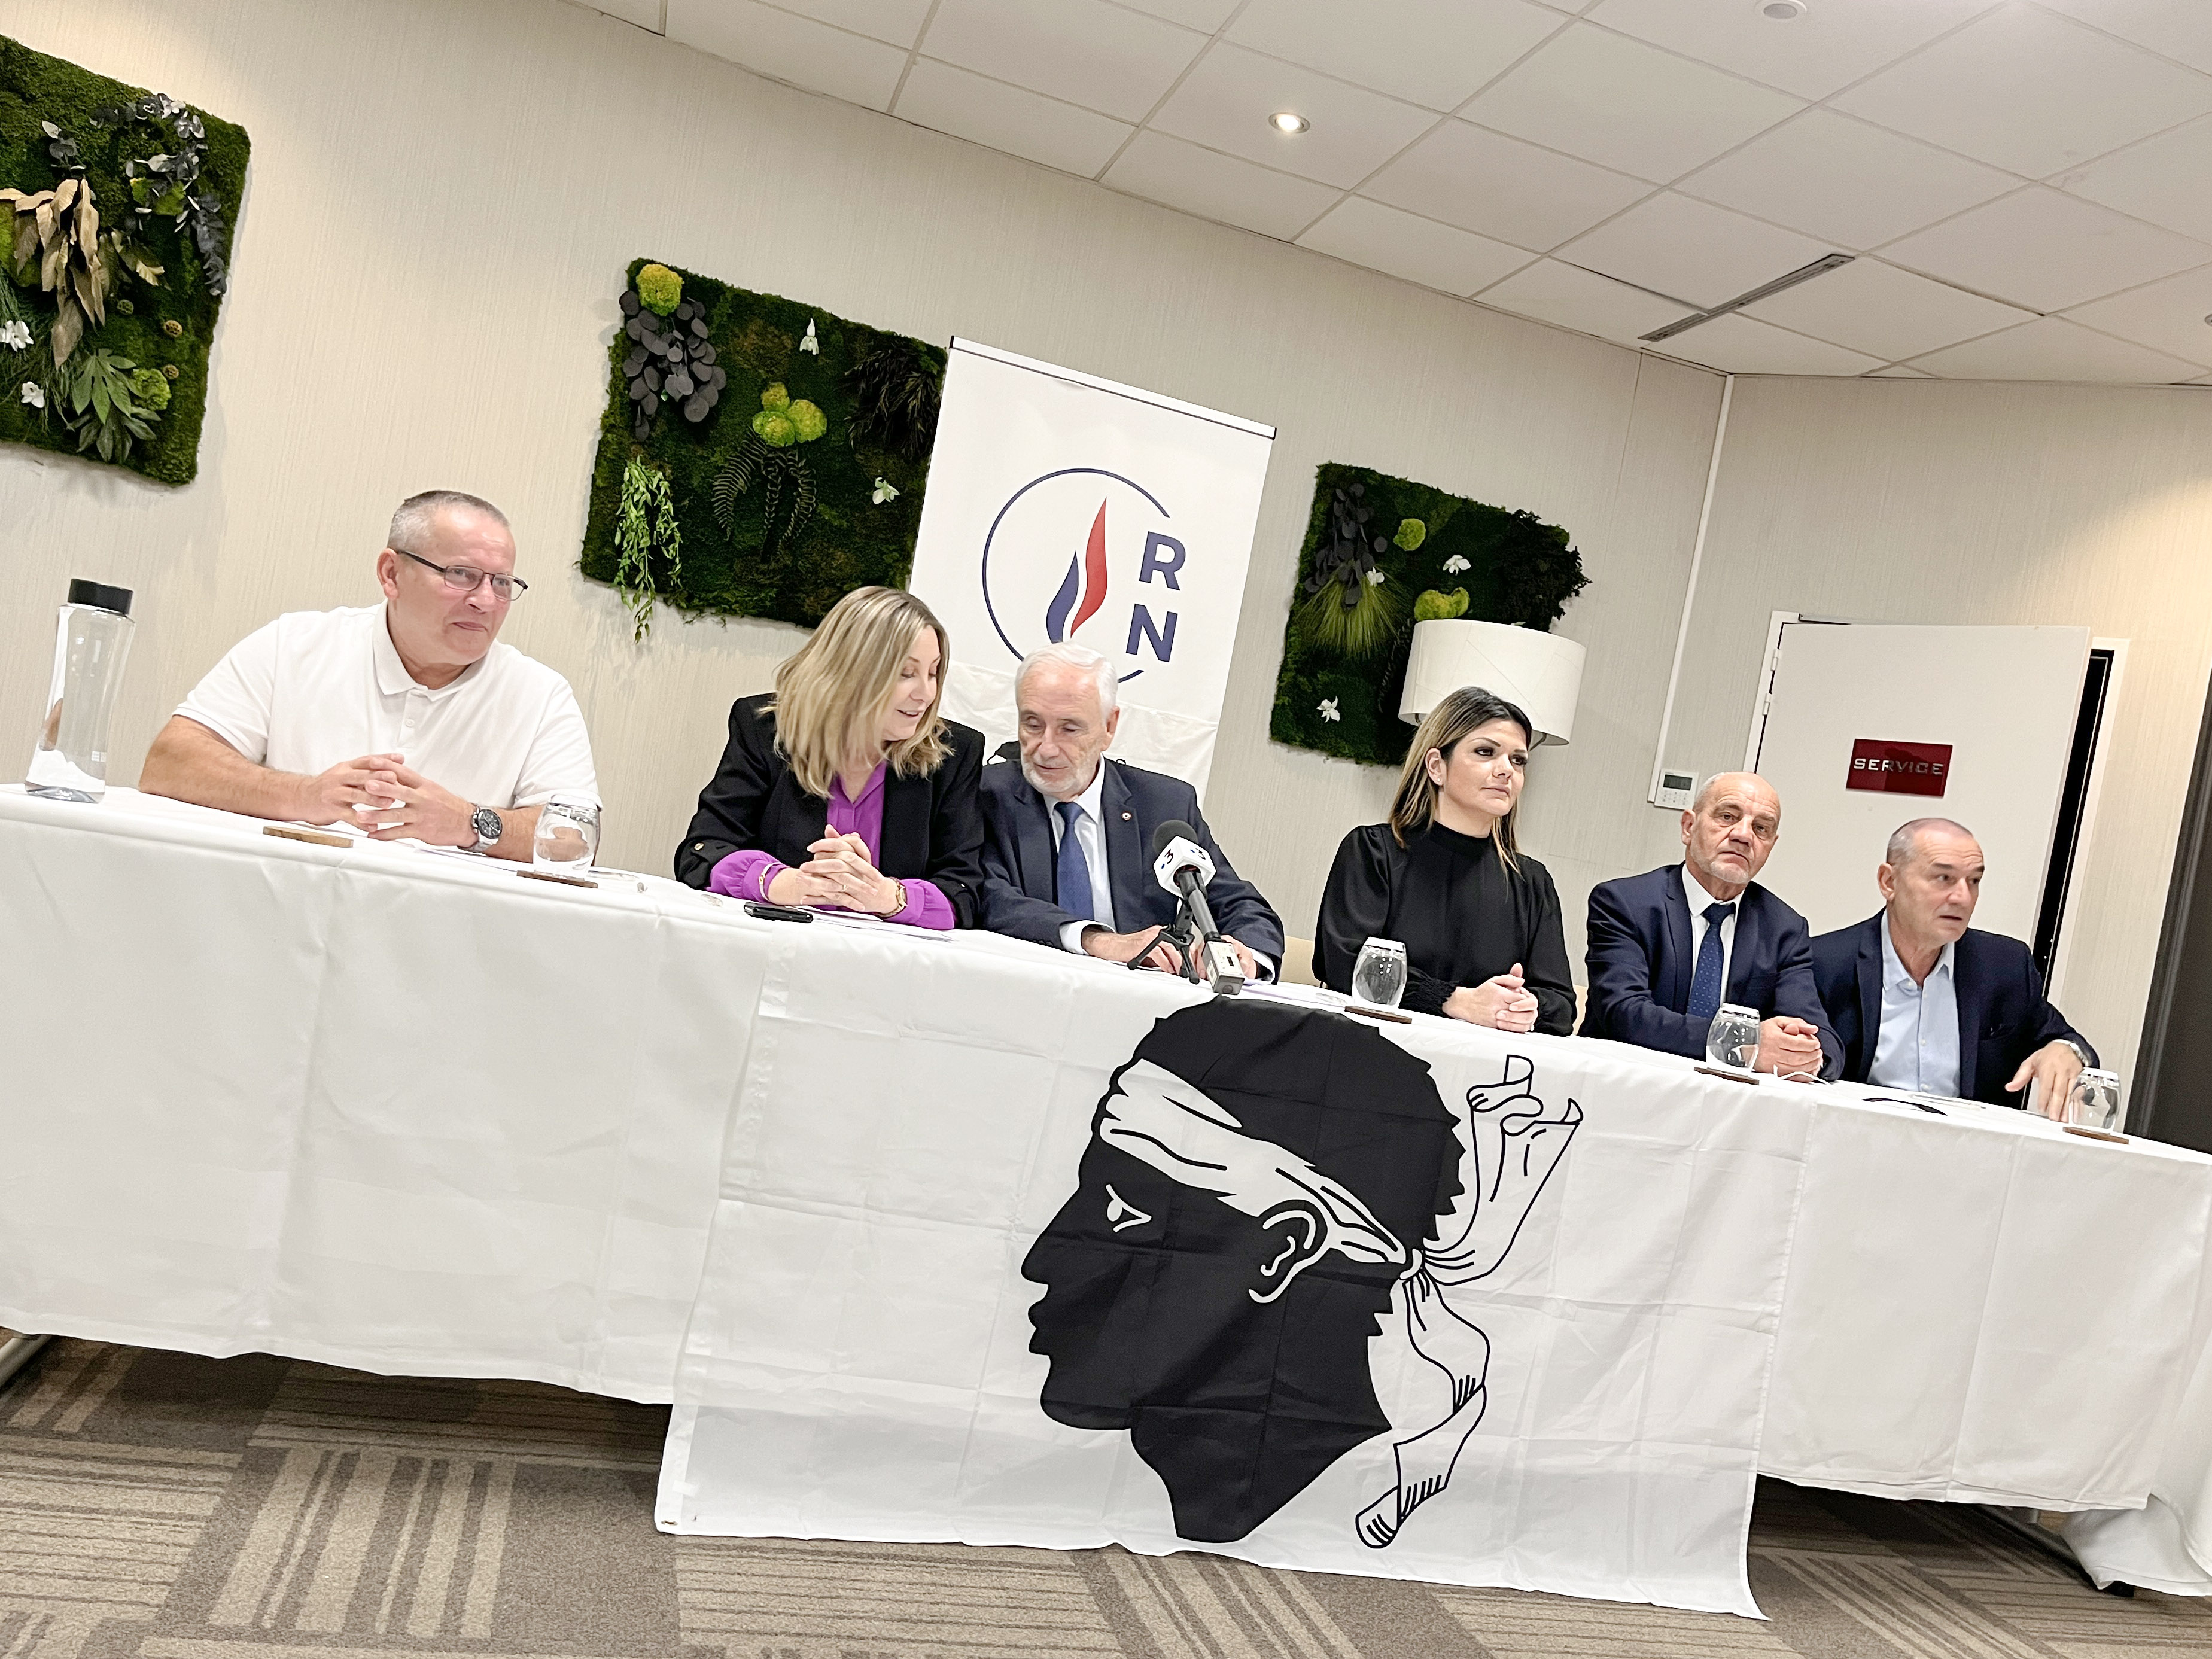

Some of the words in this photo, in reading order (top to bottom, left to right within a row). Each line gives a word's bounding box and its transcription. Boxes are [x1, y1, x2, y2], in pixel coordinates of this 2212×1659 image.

[1139, 531, 1186, 591] R
[1125, 603, 1178, 663] N
[1853, 757, 1944, 775] SERVICE
[1164, 848, 1173, 864] 3
